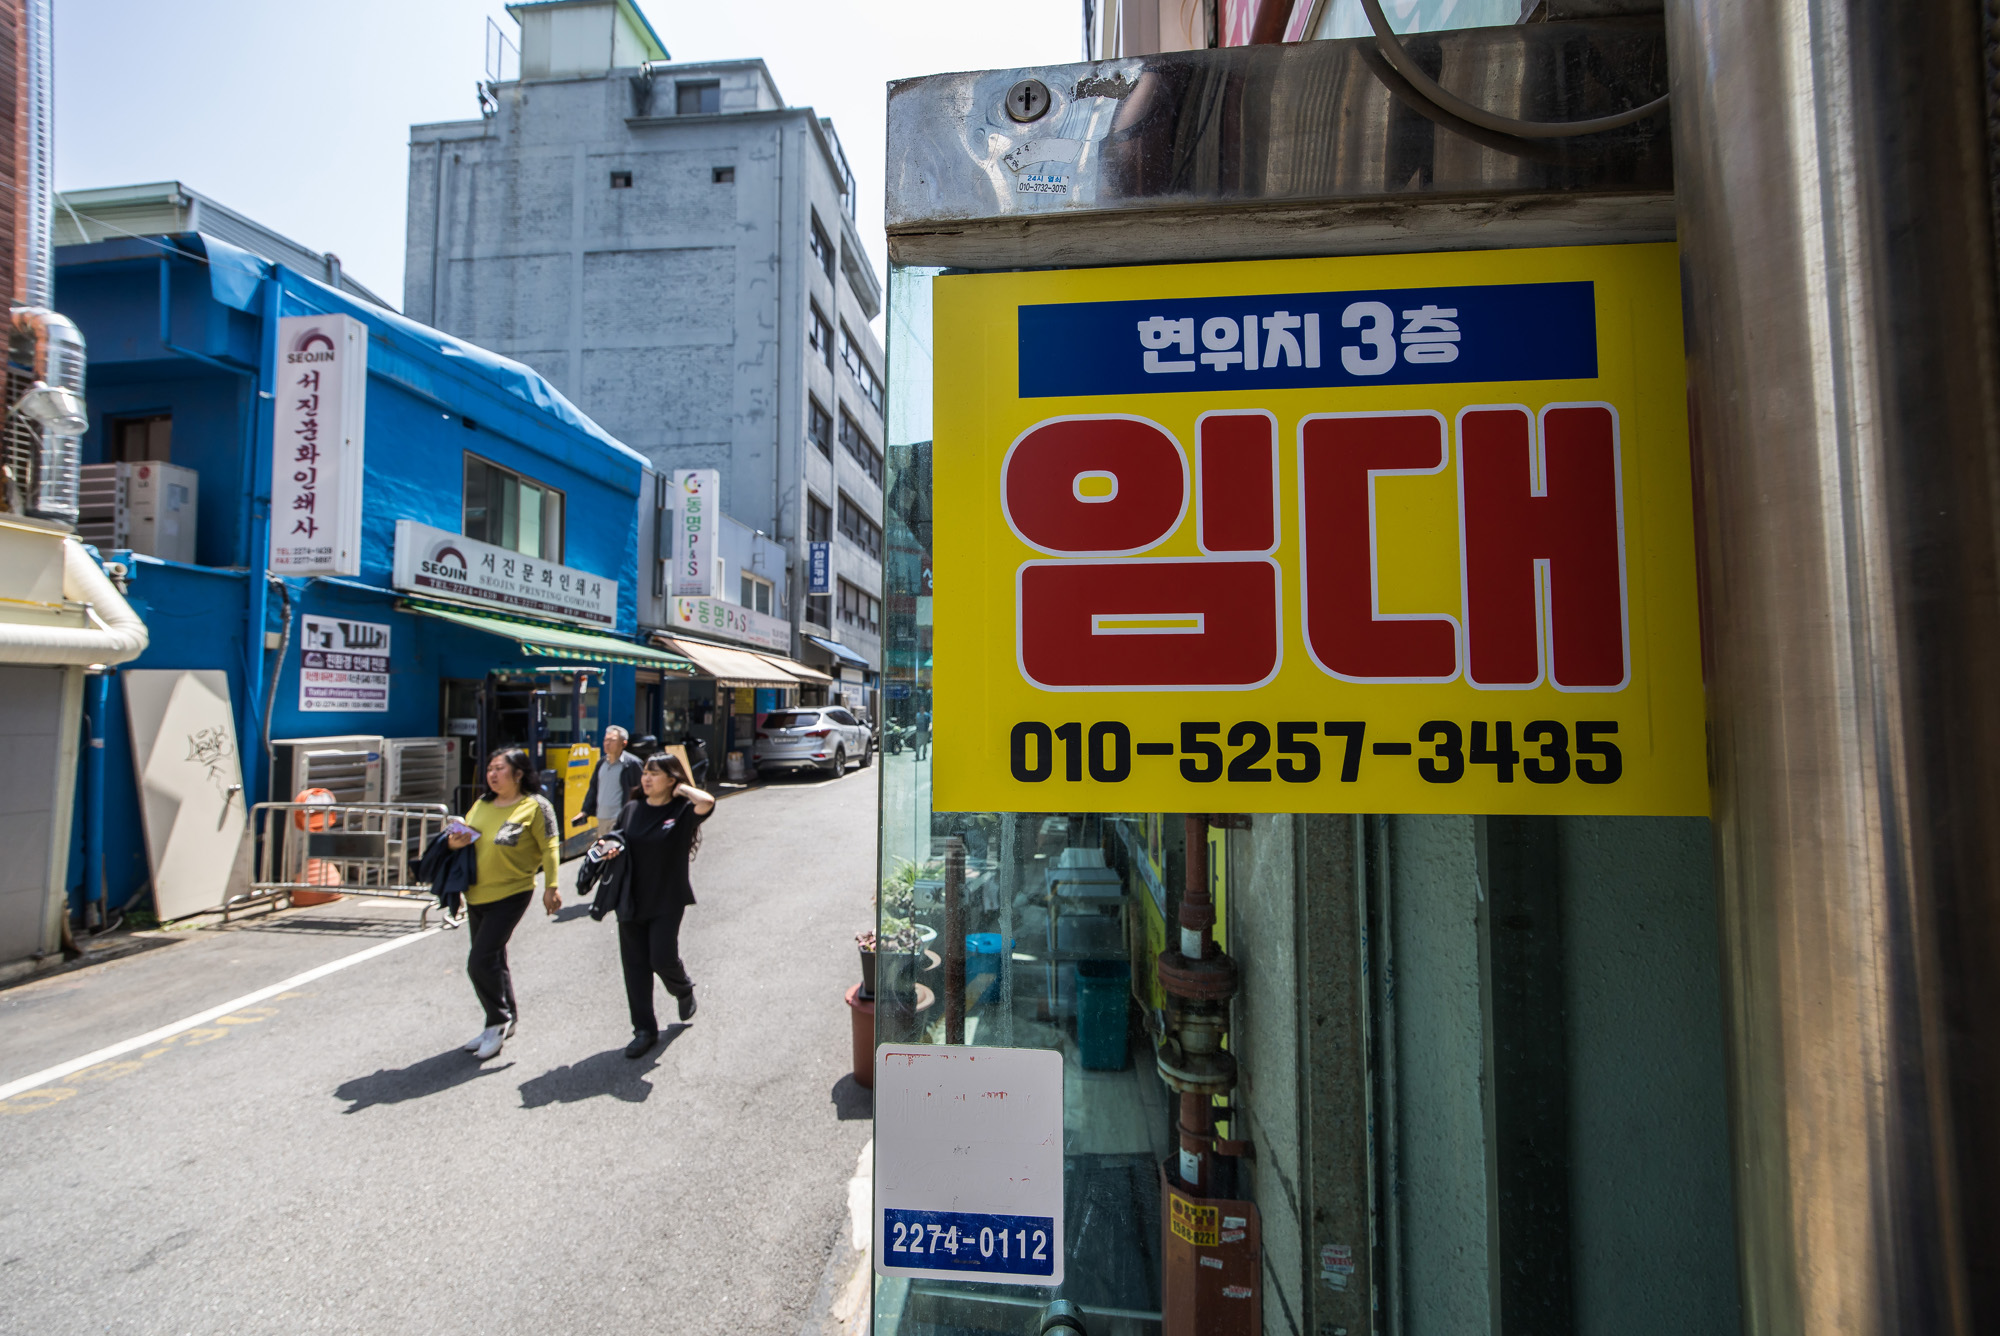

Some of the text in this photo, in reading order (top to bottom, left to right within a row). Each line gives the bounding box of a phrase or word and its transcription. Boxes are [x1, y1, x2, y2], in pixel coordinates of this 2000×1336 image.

[1019, 182, 1067, 193] 010-3732-3076
[1027, 174, 1044, 183] 24시
[287, 351, 335, 364] SEOJIN
[1137, 301, 1461, 376] 현위치 3층
[291, 369, 321, 540] 서진문화인쇄사
[1000, 401, 1631, 693] 임대
[421, 561, 468, 582] SEOJIN
[479, 575, 516, 591] SEOJIN
[519, 584, 562, 602] PRINTING
[480, 552, 602, 600] 서진문화인쇄사
[1009, 720, 1623, 785] 010-5257-3435
[892, 1221, 1047, 1261] 2274-0112
